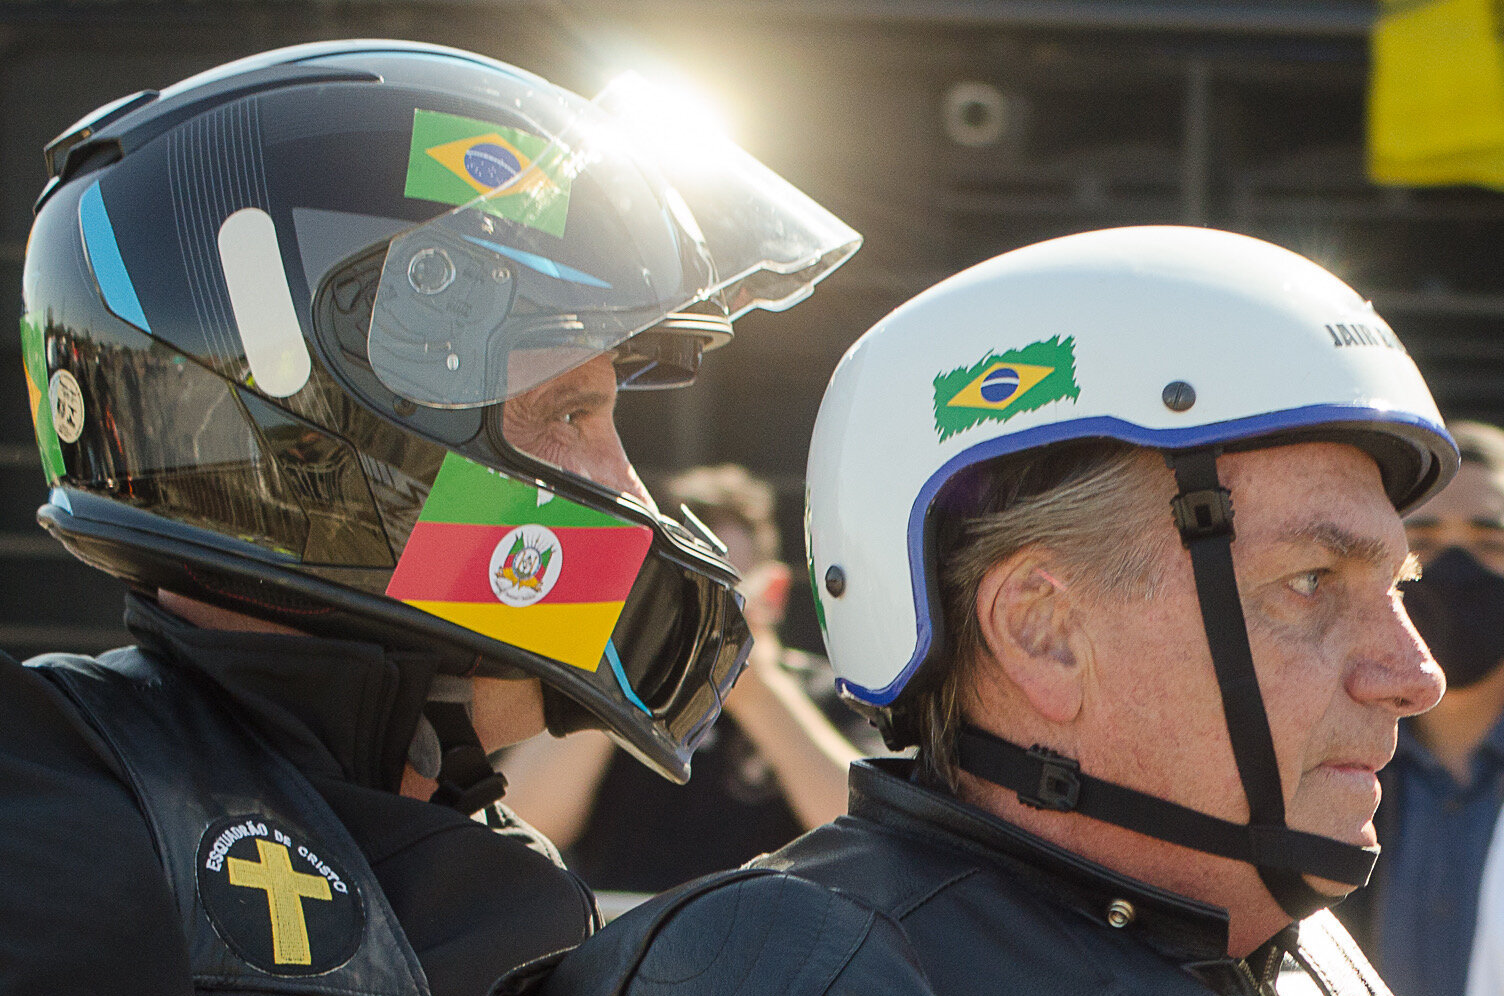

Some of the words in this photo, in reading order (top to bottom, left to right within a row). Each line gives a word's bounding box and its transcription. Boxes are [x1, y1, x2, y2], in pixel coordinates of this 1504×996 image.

[1325, 323, 1378, 347] JAIR
[206, 820, 268, 872] ESQUADRÃO
[274, 829, 292, 848] DE
[298, 846, 349, 895] CRISTO
